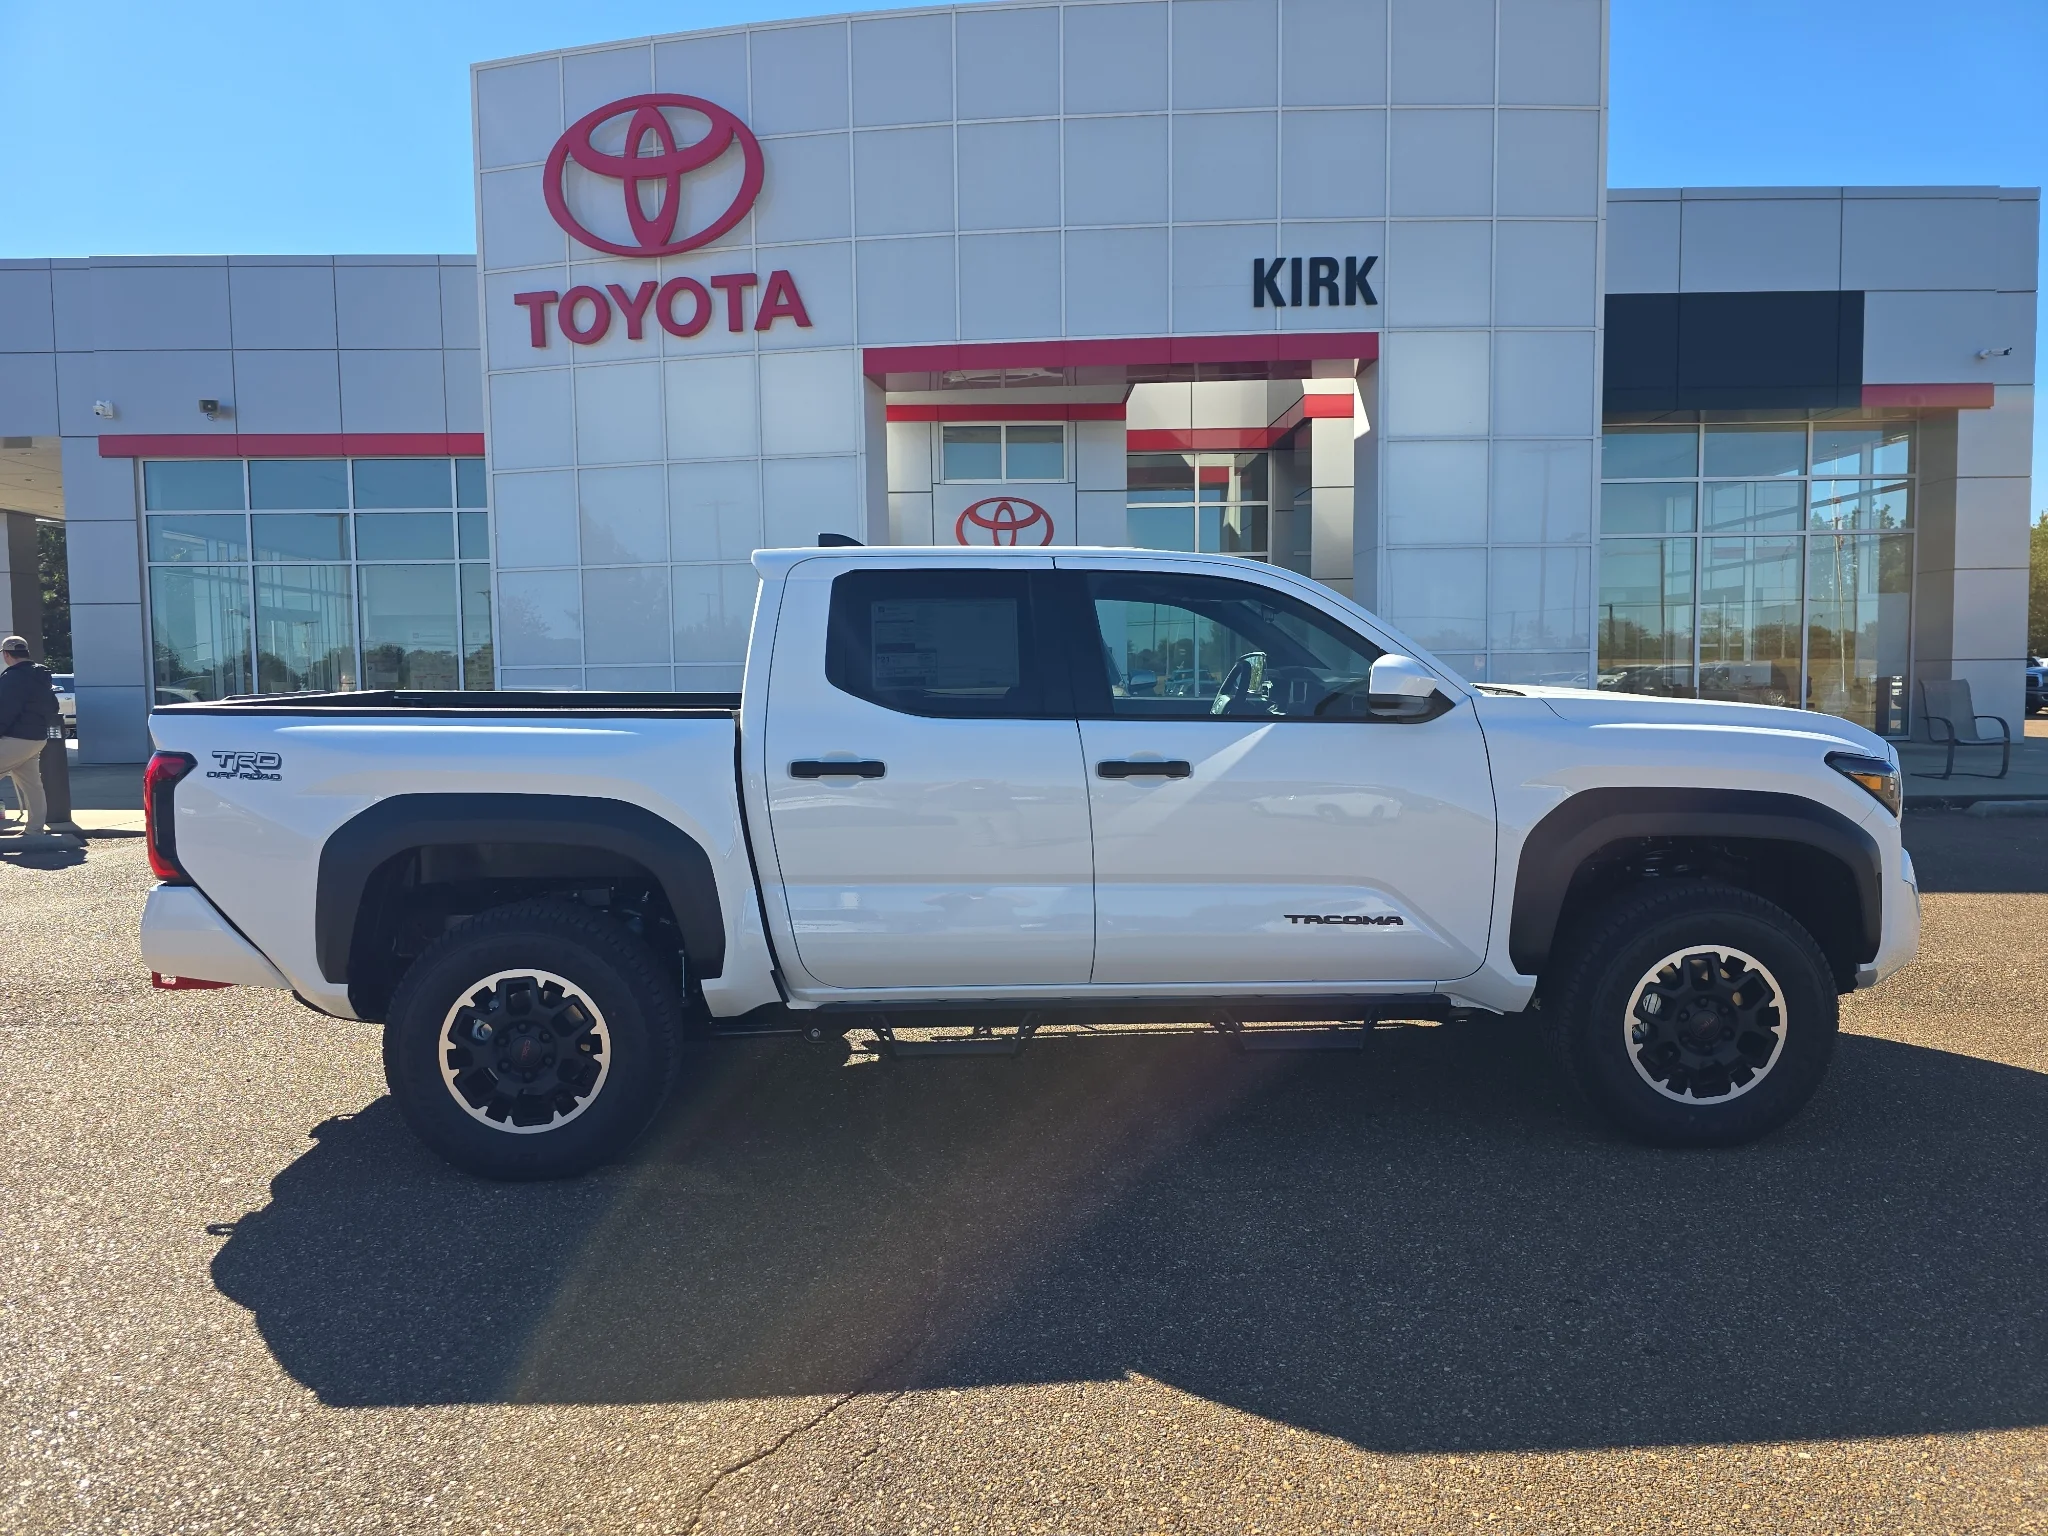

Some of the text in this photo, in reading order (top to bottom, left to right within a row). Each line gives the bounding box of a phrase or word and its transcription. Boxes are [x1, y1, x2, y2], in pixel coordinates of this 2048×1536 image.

[1253, 256, 1379, 308] KIRK
[514, 269, 813, 349] TOYOTA
[211, 750, 283, 774] TRD
[206, 771, 283, 781] OFF ROAD
[1283, 914, 1404, 926] TACOMA
